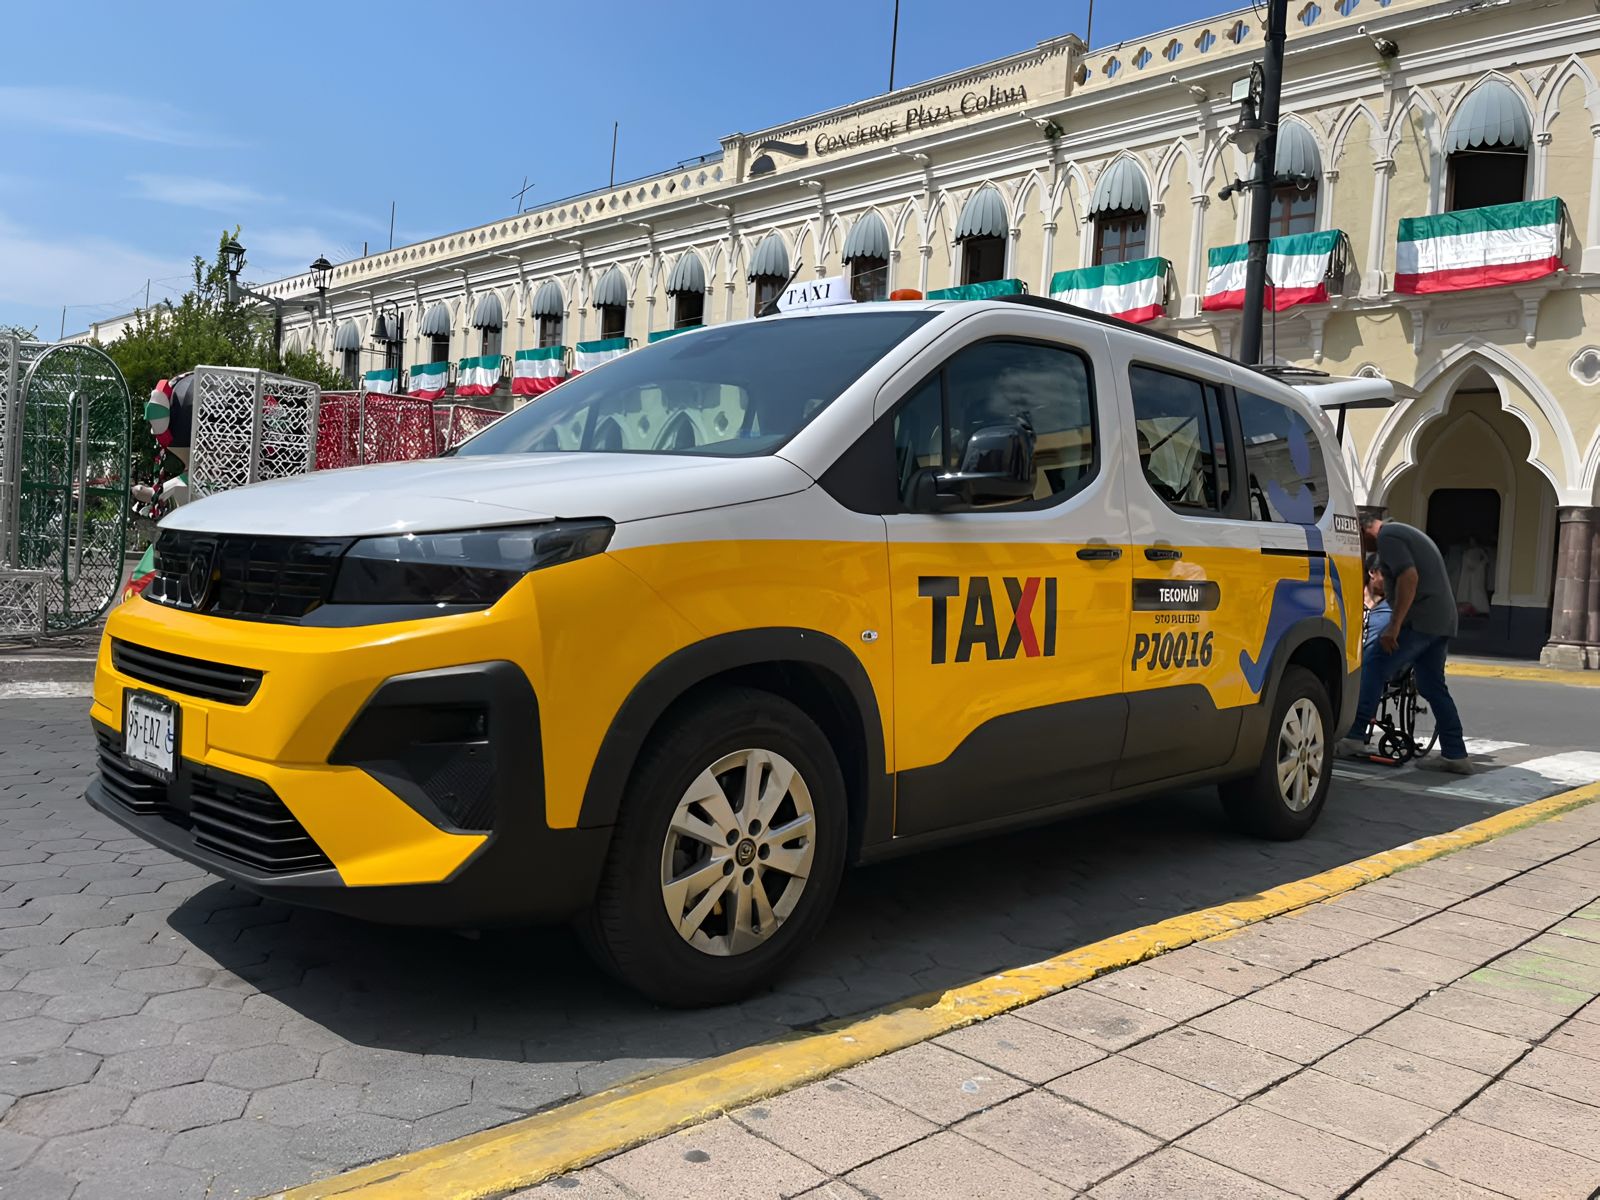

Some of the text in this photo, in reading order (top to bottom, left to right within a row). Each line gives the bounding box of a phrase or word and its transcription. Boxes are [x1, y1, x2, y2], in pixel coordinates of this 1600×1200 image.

[787, 284, 830, 305] TAXI
[918, 576, 1057, 664] TAXI
[1131, 631, 1214, 671] PJ0016
